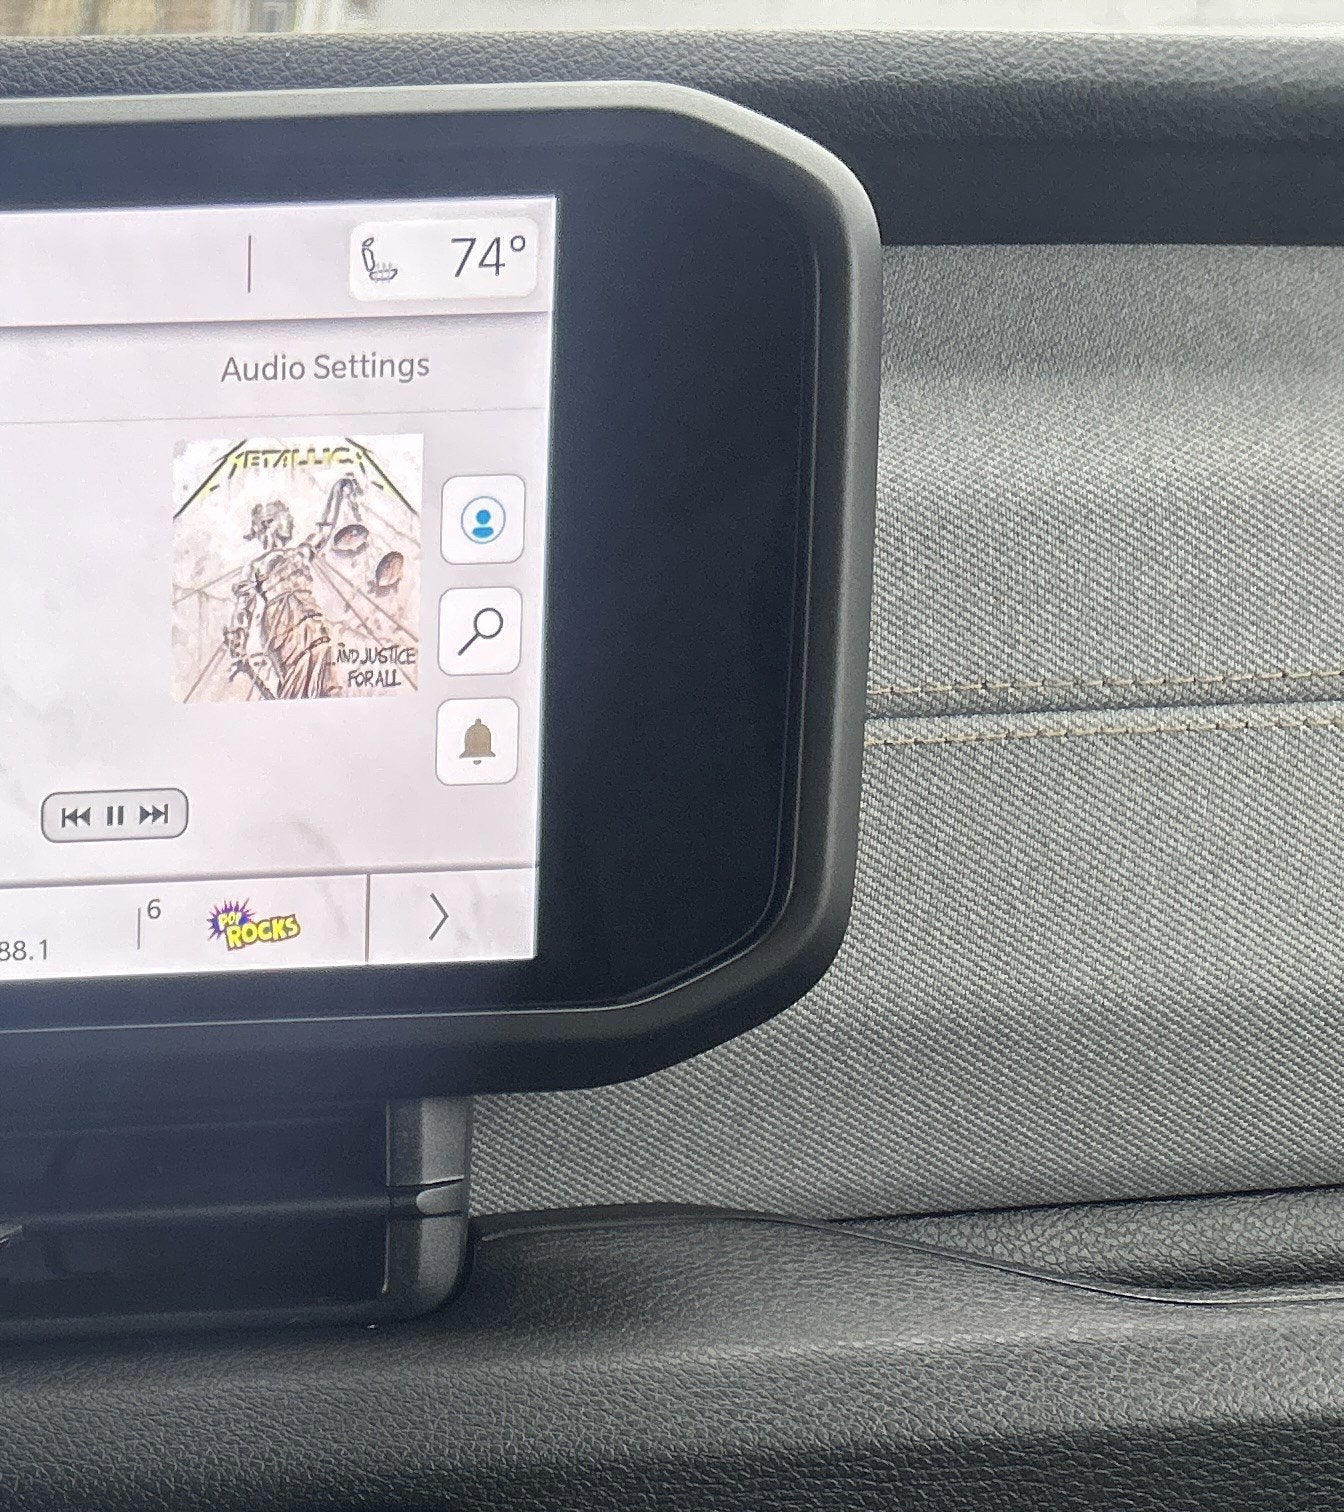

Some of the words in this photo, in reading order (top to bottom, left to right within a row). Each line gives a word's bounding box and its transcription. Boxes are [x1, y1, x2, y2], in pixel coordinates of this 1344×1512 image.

[451, 234, 527, 278] 74°
[220, 353, 306, 383] Audio
[313, 351, 430, 384] Settings
[374, 668, 403, 688] ALL
[146, 898, 162, 920] 6
[224, 913, 301, 951] ROCKS
